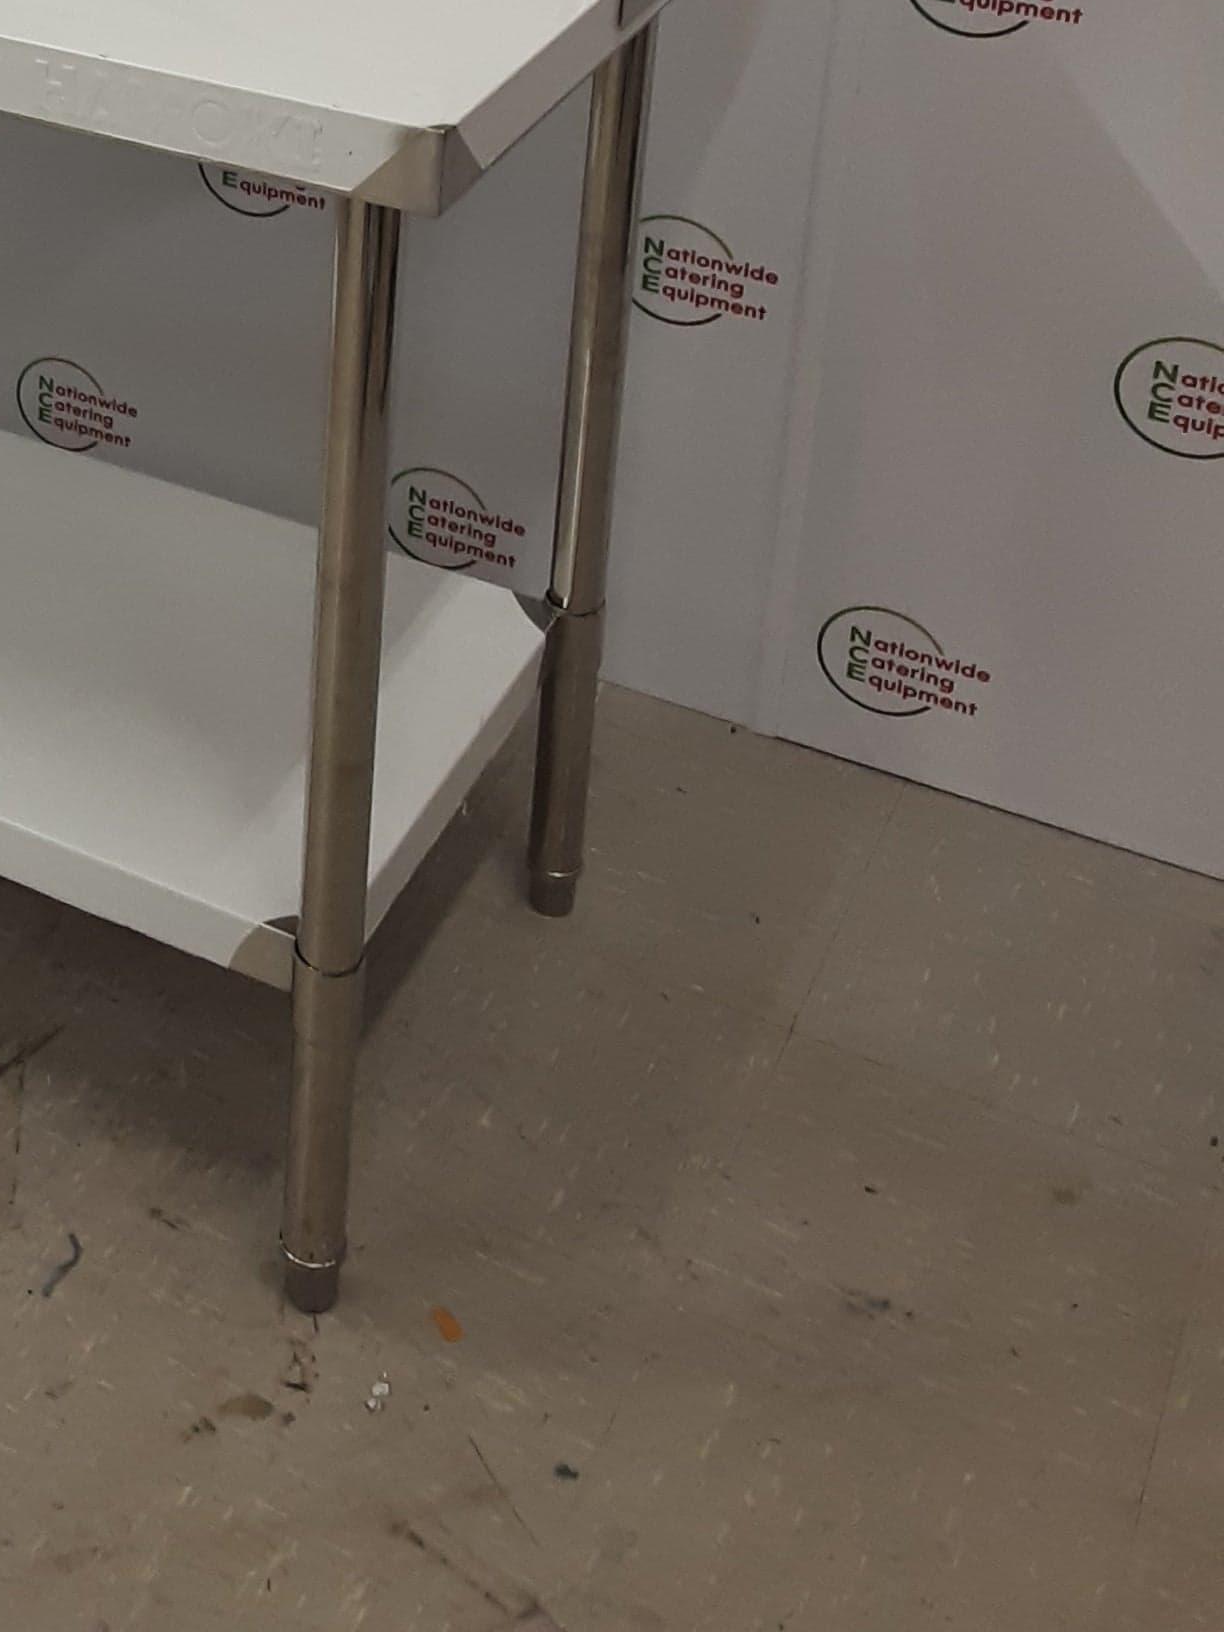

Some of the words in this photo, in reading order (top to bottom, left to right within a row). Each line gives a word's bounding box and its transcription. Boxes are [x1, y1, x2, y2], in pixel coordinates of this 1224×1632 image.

[222, 170, 325, 210] Equipment
[643, 256, 745, 298] Catering
[644, 236, 779, 285] Nationwide
[642, 274, 767, 320] Equipment
[39, 375, 137, 417] Nationwide
[39, 393, 113, 428] Catering
[39, 408, 131, 447] Equipment
[1147, 401, 1224, 440] Equip
[408, 504, 496, 547] Catering
[409, 486, 525, 537] Nationwide
[407, 519, 516, 568] Equipment
[848, 646, 955, 694] Catering
[849, 626, 991, 683] Nationwide
[847, 662, 977, 716] Equipment
